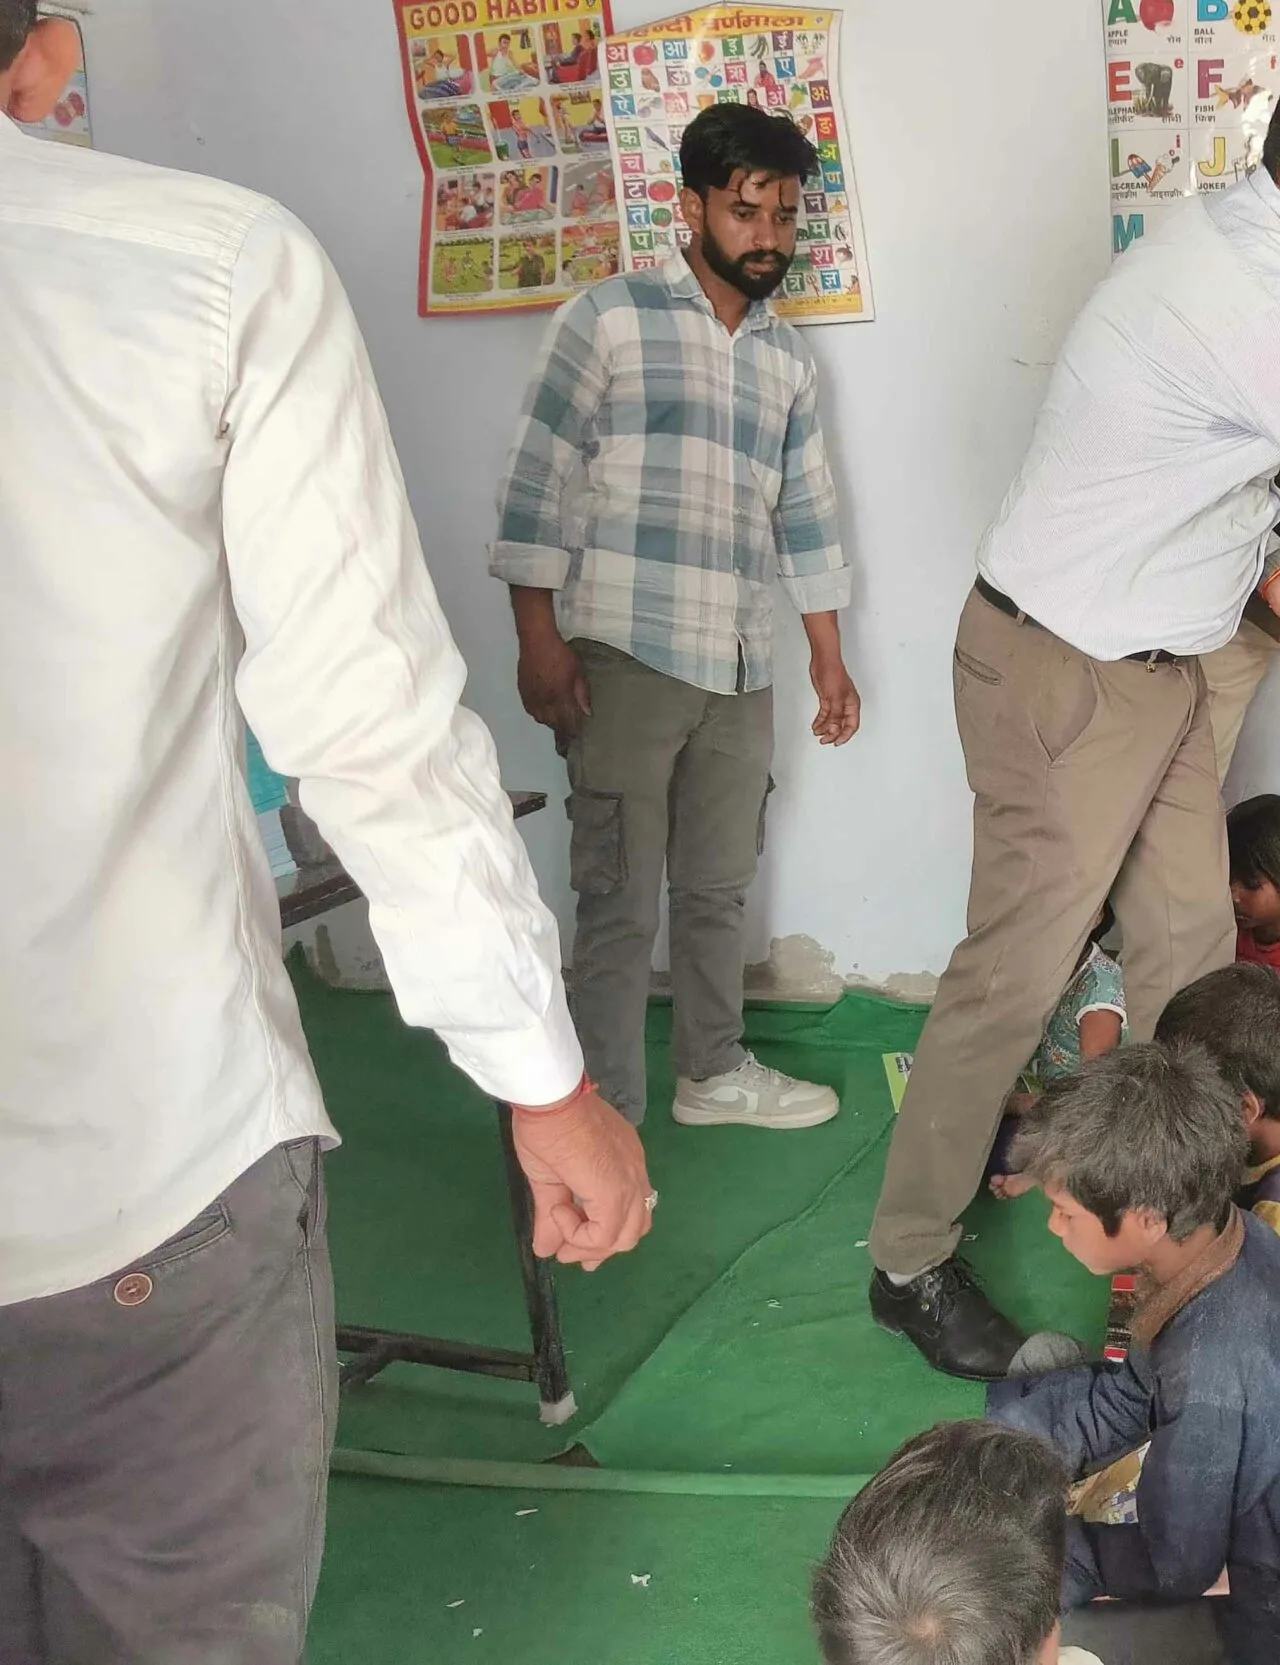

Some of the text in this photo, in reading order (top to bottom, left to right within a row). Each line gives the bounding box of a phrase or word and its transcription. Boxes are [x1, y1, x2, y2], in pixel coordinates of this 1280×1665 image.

[410, 2, 477, 31] GOOD
[1108, 0, 1137, 26] A
[1194, 28, 1215, 36] BALL
[607, 46, 626, 61] अ
[664, 41, 686, 57] आ
[1174, 58, 1184, 69] e
[611, 71, 629, 87] उ
[1108, 61, 1133, 102] E
[1197, 59, 1225, 99] F
[1194, 105, 1215, 113] FISH
[617, 129, 638, 145] क
[1110, 138, 1120, 178] I
[1198, 137, 1225, 177] J
[624, 182, 645, 198] ट
[1111, 182, 1148, 191] CE-CREAM
[1197, 182, 1226, 190] JOKER
[806, 195, 824, 211] न
[627, 207, 647, 224] त
[809, 221, 828, 236] म
[1114, 214, 1144, 252] M
[631, 232, 650, 249] प
